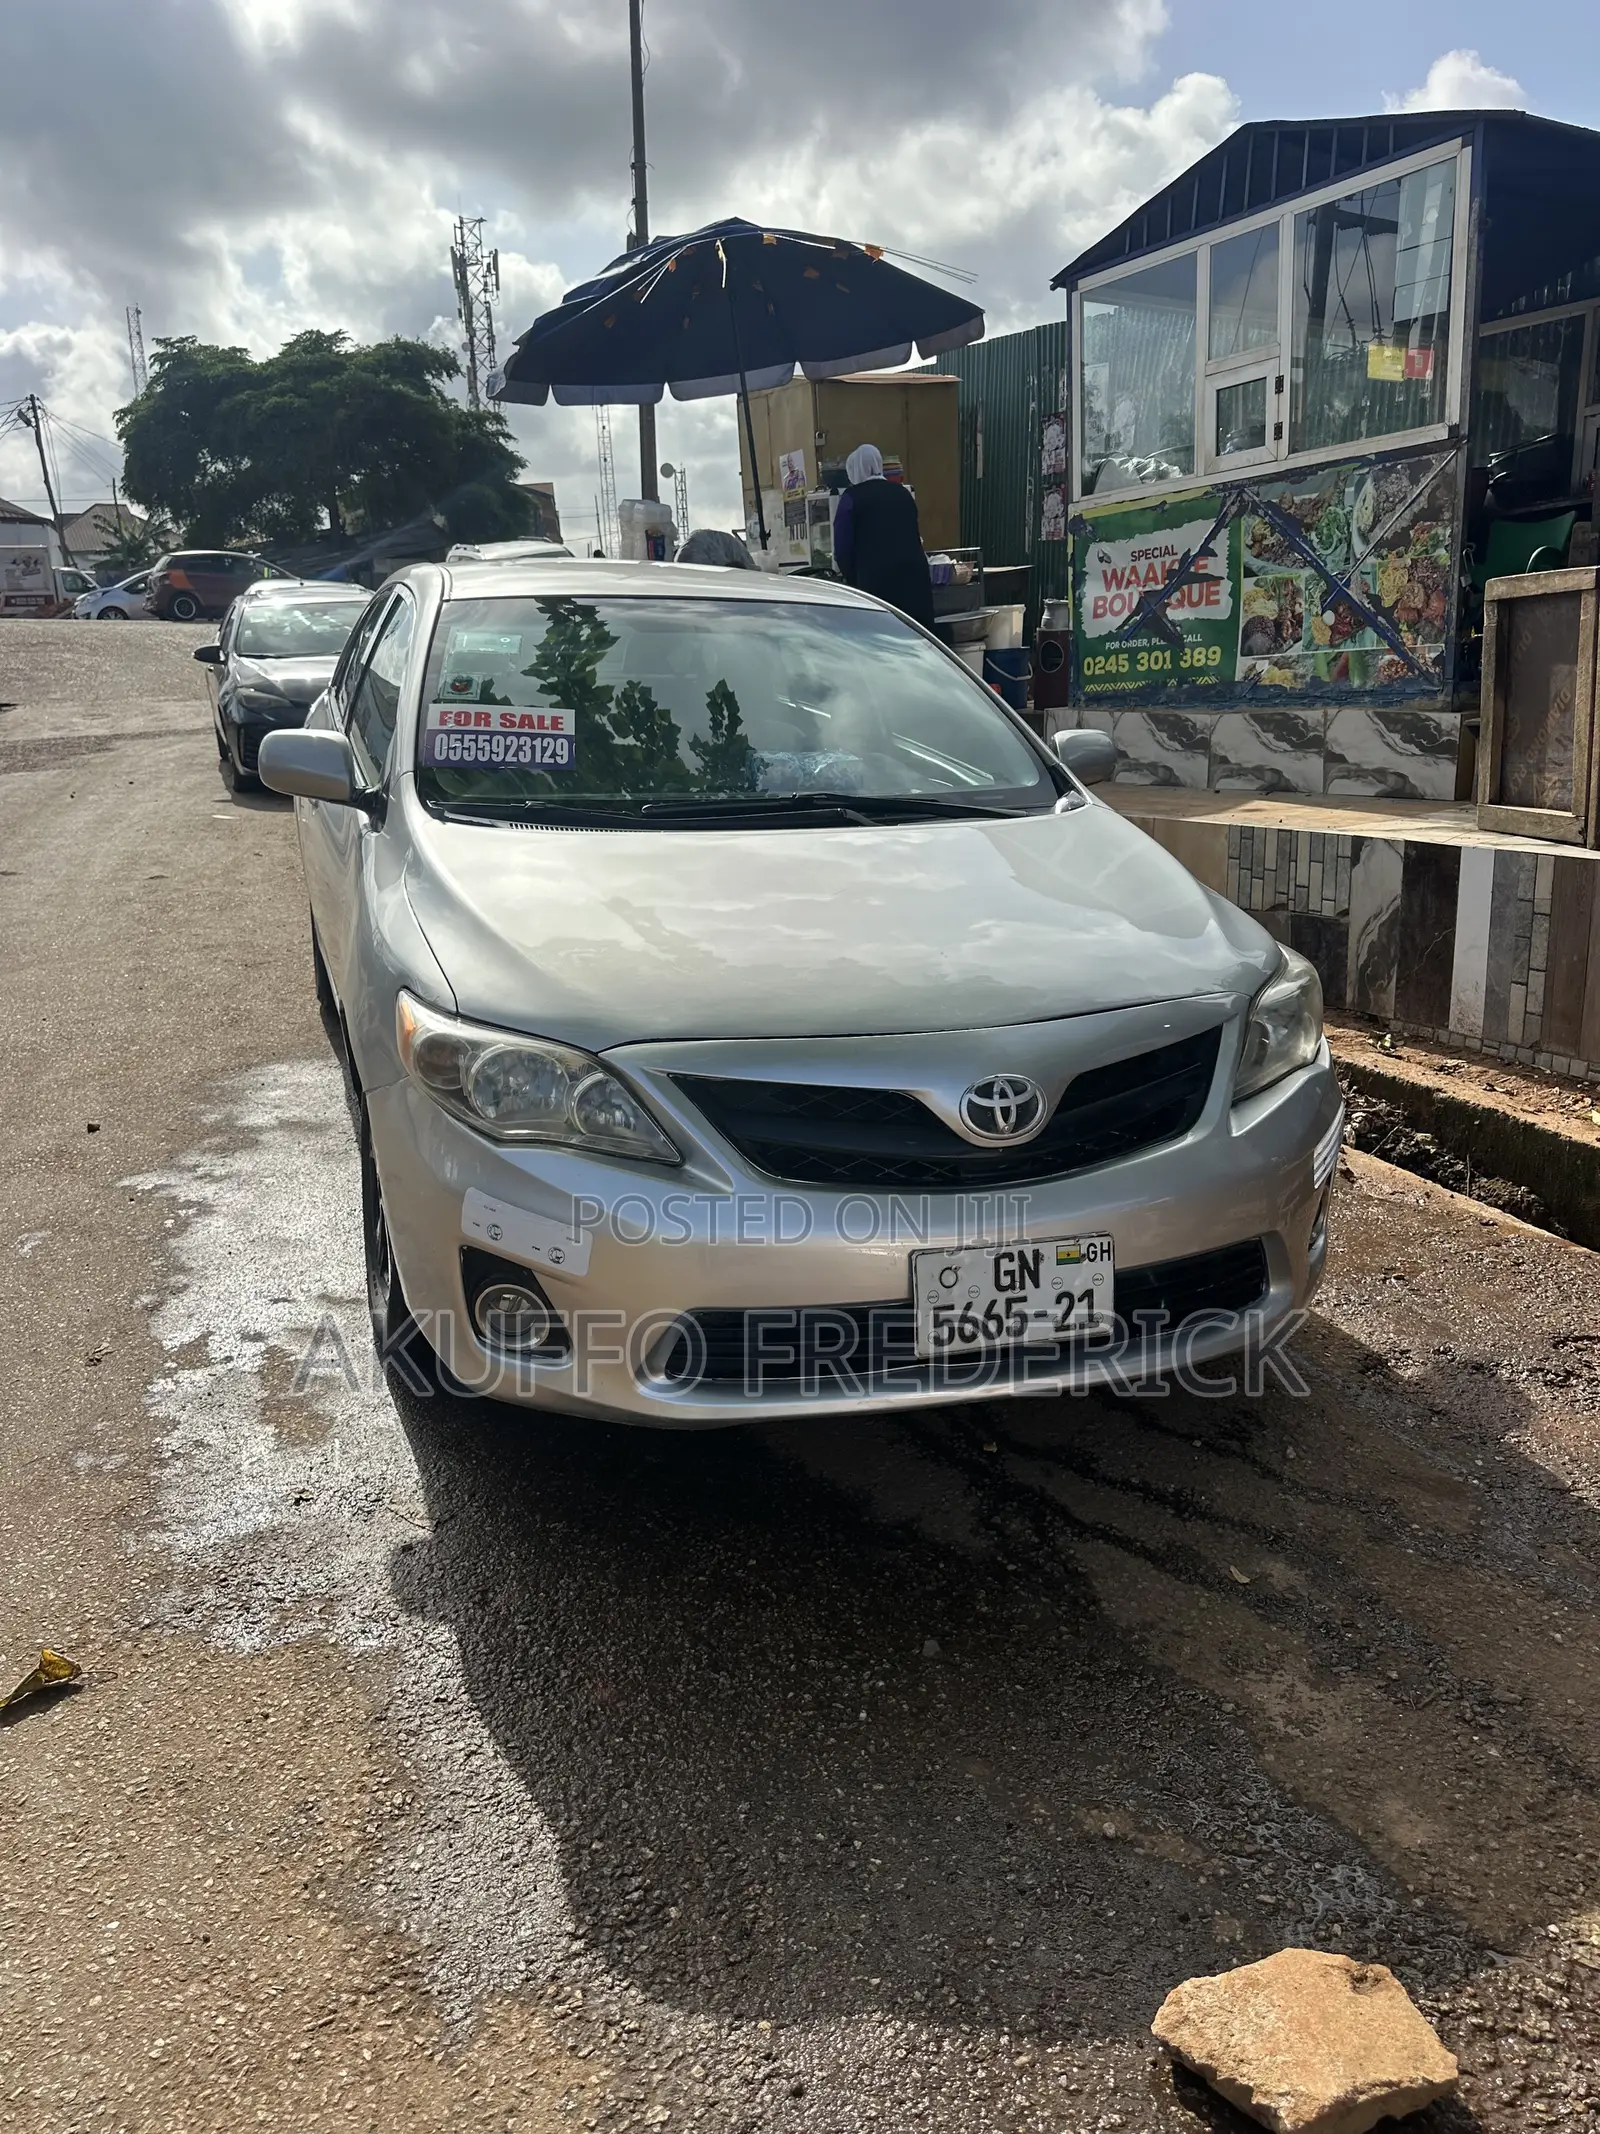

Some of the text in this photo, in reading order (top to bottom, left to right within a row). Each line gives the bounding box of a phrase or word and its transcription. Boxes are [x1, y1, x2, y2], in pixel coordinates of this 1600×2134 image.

[1131, 544, 1178, 562] SPECIAL
[1102, 557, 1209, 592] WAAKE
[1092, 581, 1220, 619] BOUQUE
[1105, 642, 1121, 650] FOR
[1121, 638, 1150, 649] ORDER,
[1083, 646, 1222, 675] 0245 301 389
[439, 710, 564, 731] FOR SALE
[434, 733, 569, 764] 0555923129
[994, 1241, 1111, 1292] GN GH
[933, 1288, 1100, 1347] 5665-21
